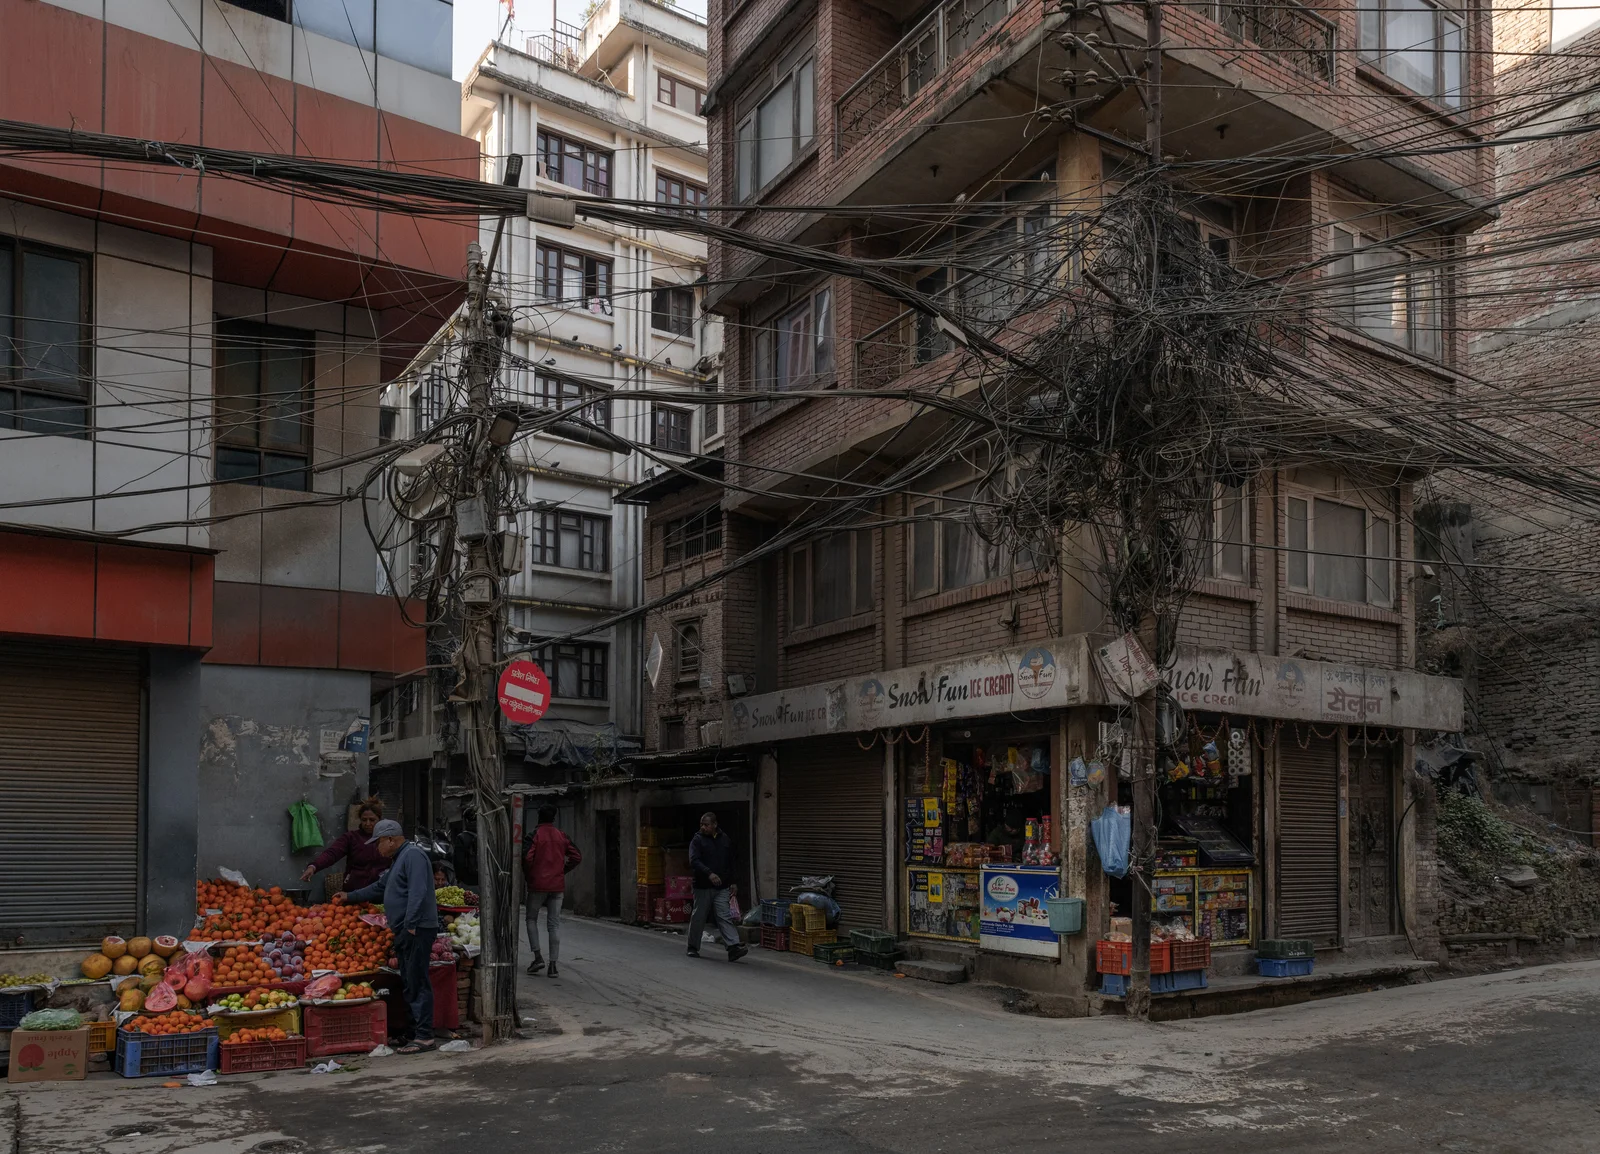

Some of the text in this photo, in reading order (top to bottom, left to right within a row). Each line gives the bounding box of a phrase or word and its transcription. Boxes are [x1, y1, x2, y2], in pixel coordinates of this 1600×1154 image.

[888, 673, 1014, 709] Snow Fun ICE CREAM
[1176, 692, 1238, 706] ICE CREA
[1326, 686, 1384, 720] सैलून
[48, 1048, 79, 1059] Apple
